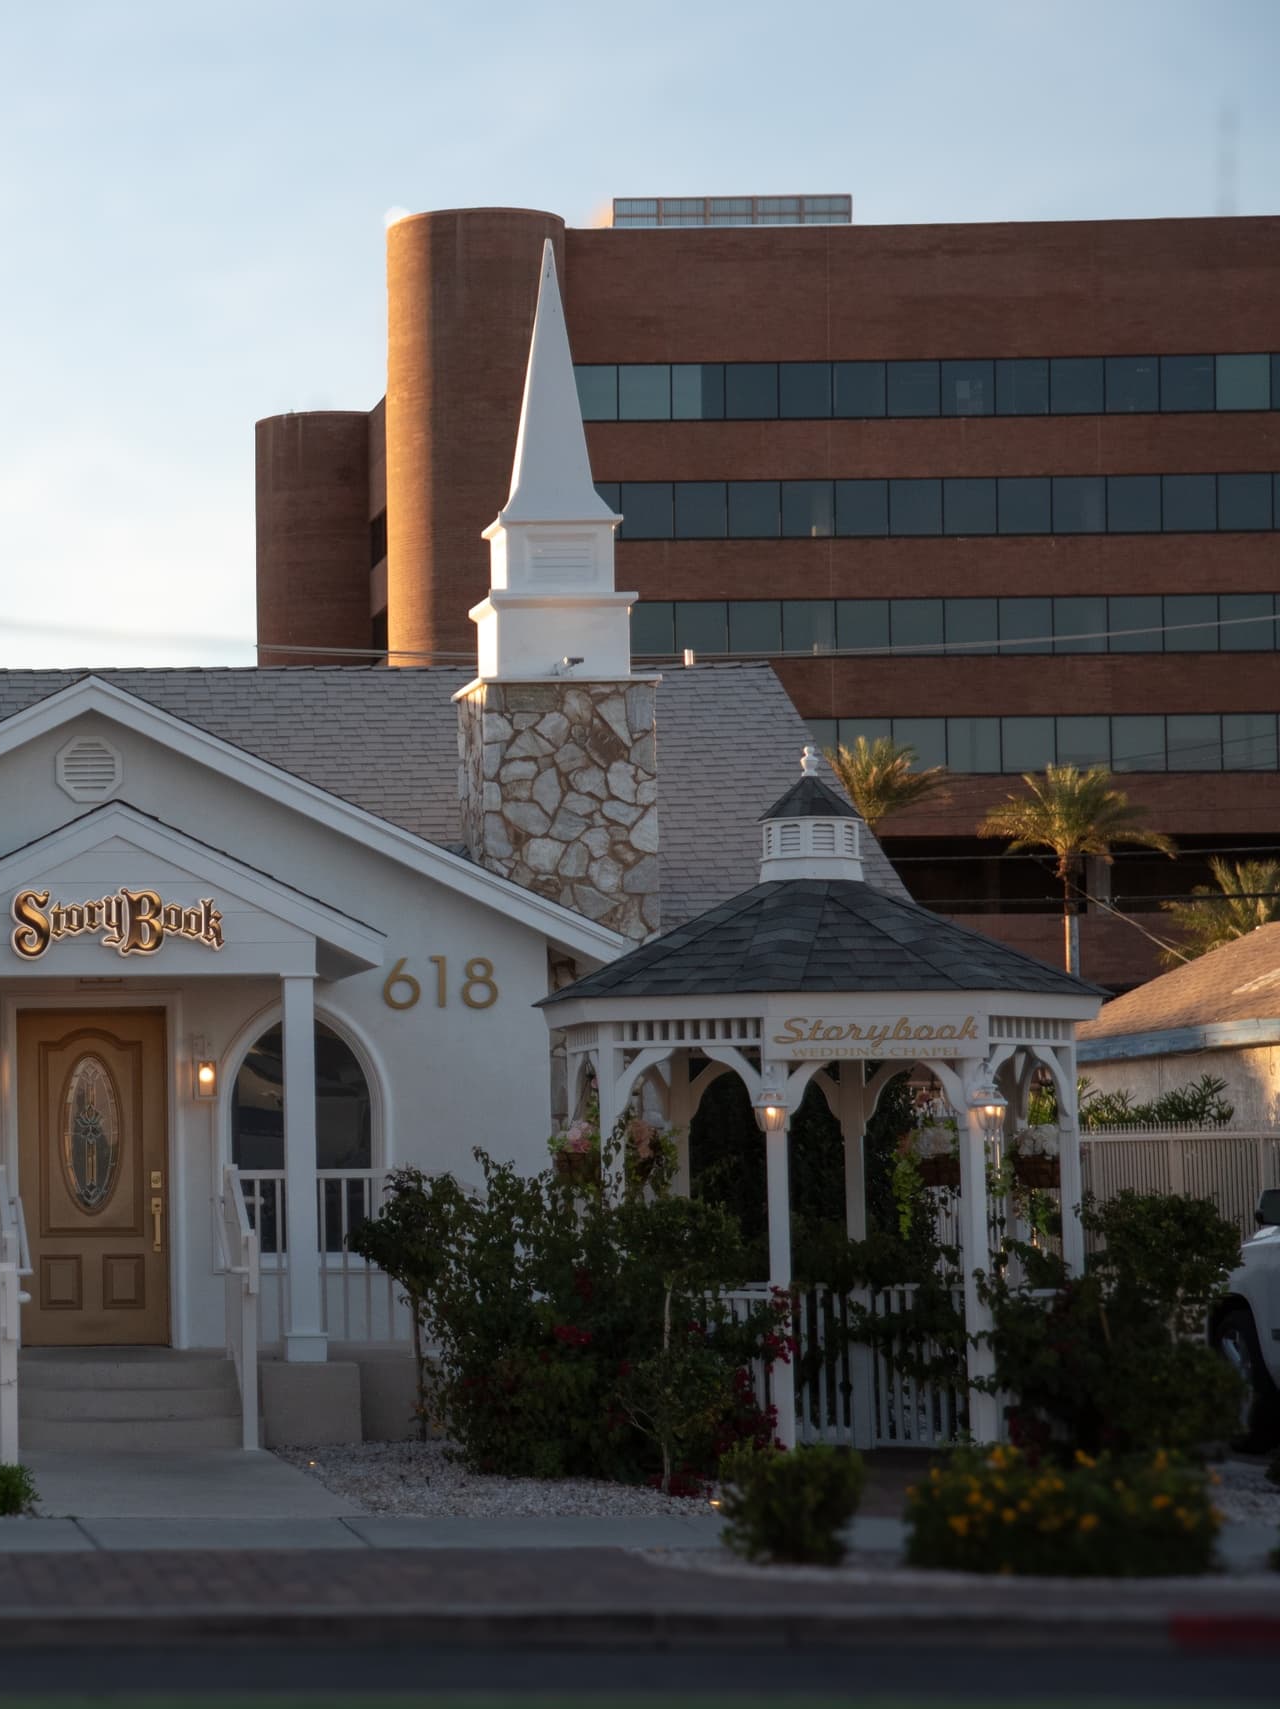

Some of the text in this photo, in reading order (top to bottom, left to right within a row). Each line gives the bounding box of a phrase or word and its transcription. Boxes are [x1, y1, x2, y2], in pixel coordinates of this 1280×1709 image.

[383, 955, 498, 1010] 618
[774, 1016, 978, 1047] Storybook
[791, 1047, 960, 1057] WEDDING CHAPEL
